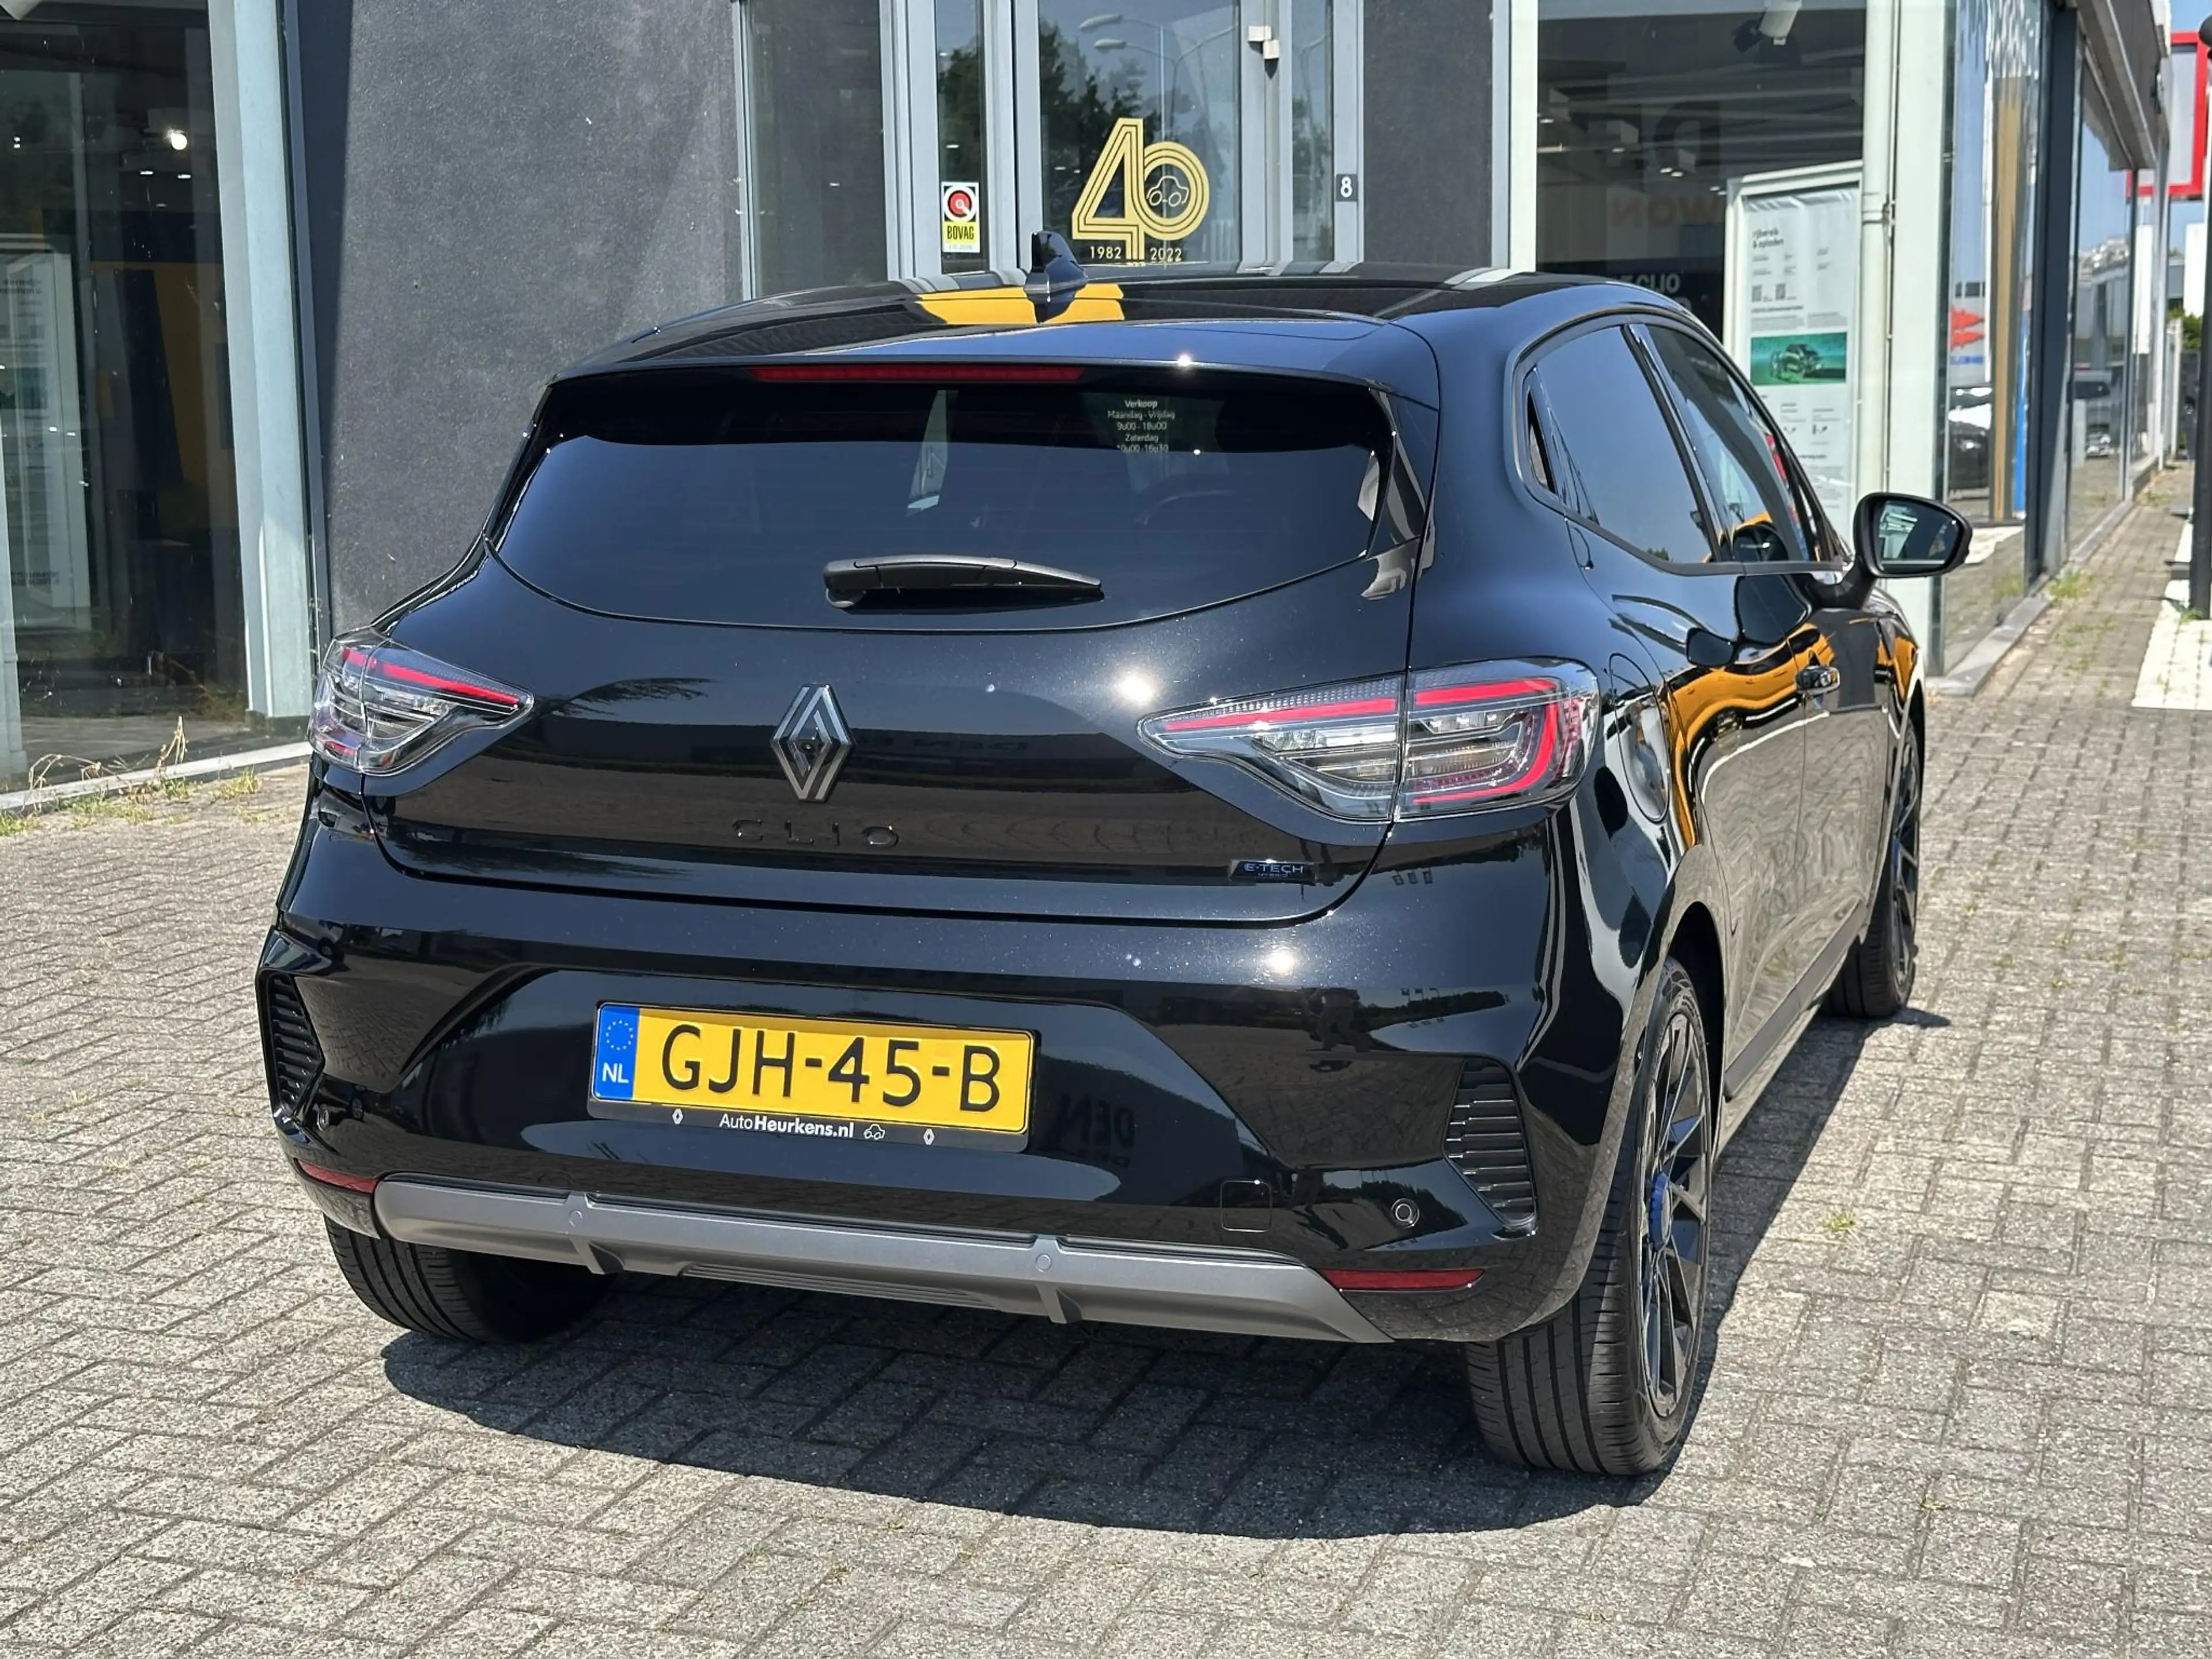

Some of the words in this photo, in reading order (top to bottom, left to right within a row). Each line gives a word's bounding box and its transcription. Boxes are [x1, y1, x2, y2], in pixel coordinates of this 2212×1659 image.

[1071, 118, 1210, 260] 40
[1339, 176, 1353, 198] 8
[946, 225, 975, 240] BOVAG
[1090, 246, 1122, 260] 1982
[1150, 247, 1182, 263] 2022
[1124, 399, 1158, 409] Verkoop
[1107, 410, 1143, 421] Maandag
[1148, 410, 1176, 421] Vrijdag
[1125, 433, 1159, 443] Zaterdag
[732, 819, 899, 849] CLIO
[1244, 863, 1304, 874] E-TECH
[602, 1062, 629, 1085] NL
[661, 1023, 1001, 1113] GJH-45-B
[719, 1112, 854, 1139] AutoHeurkens.nl
